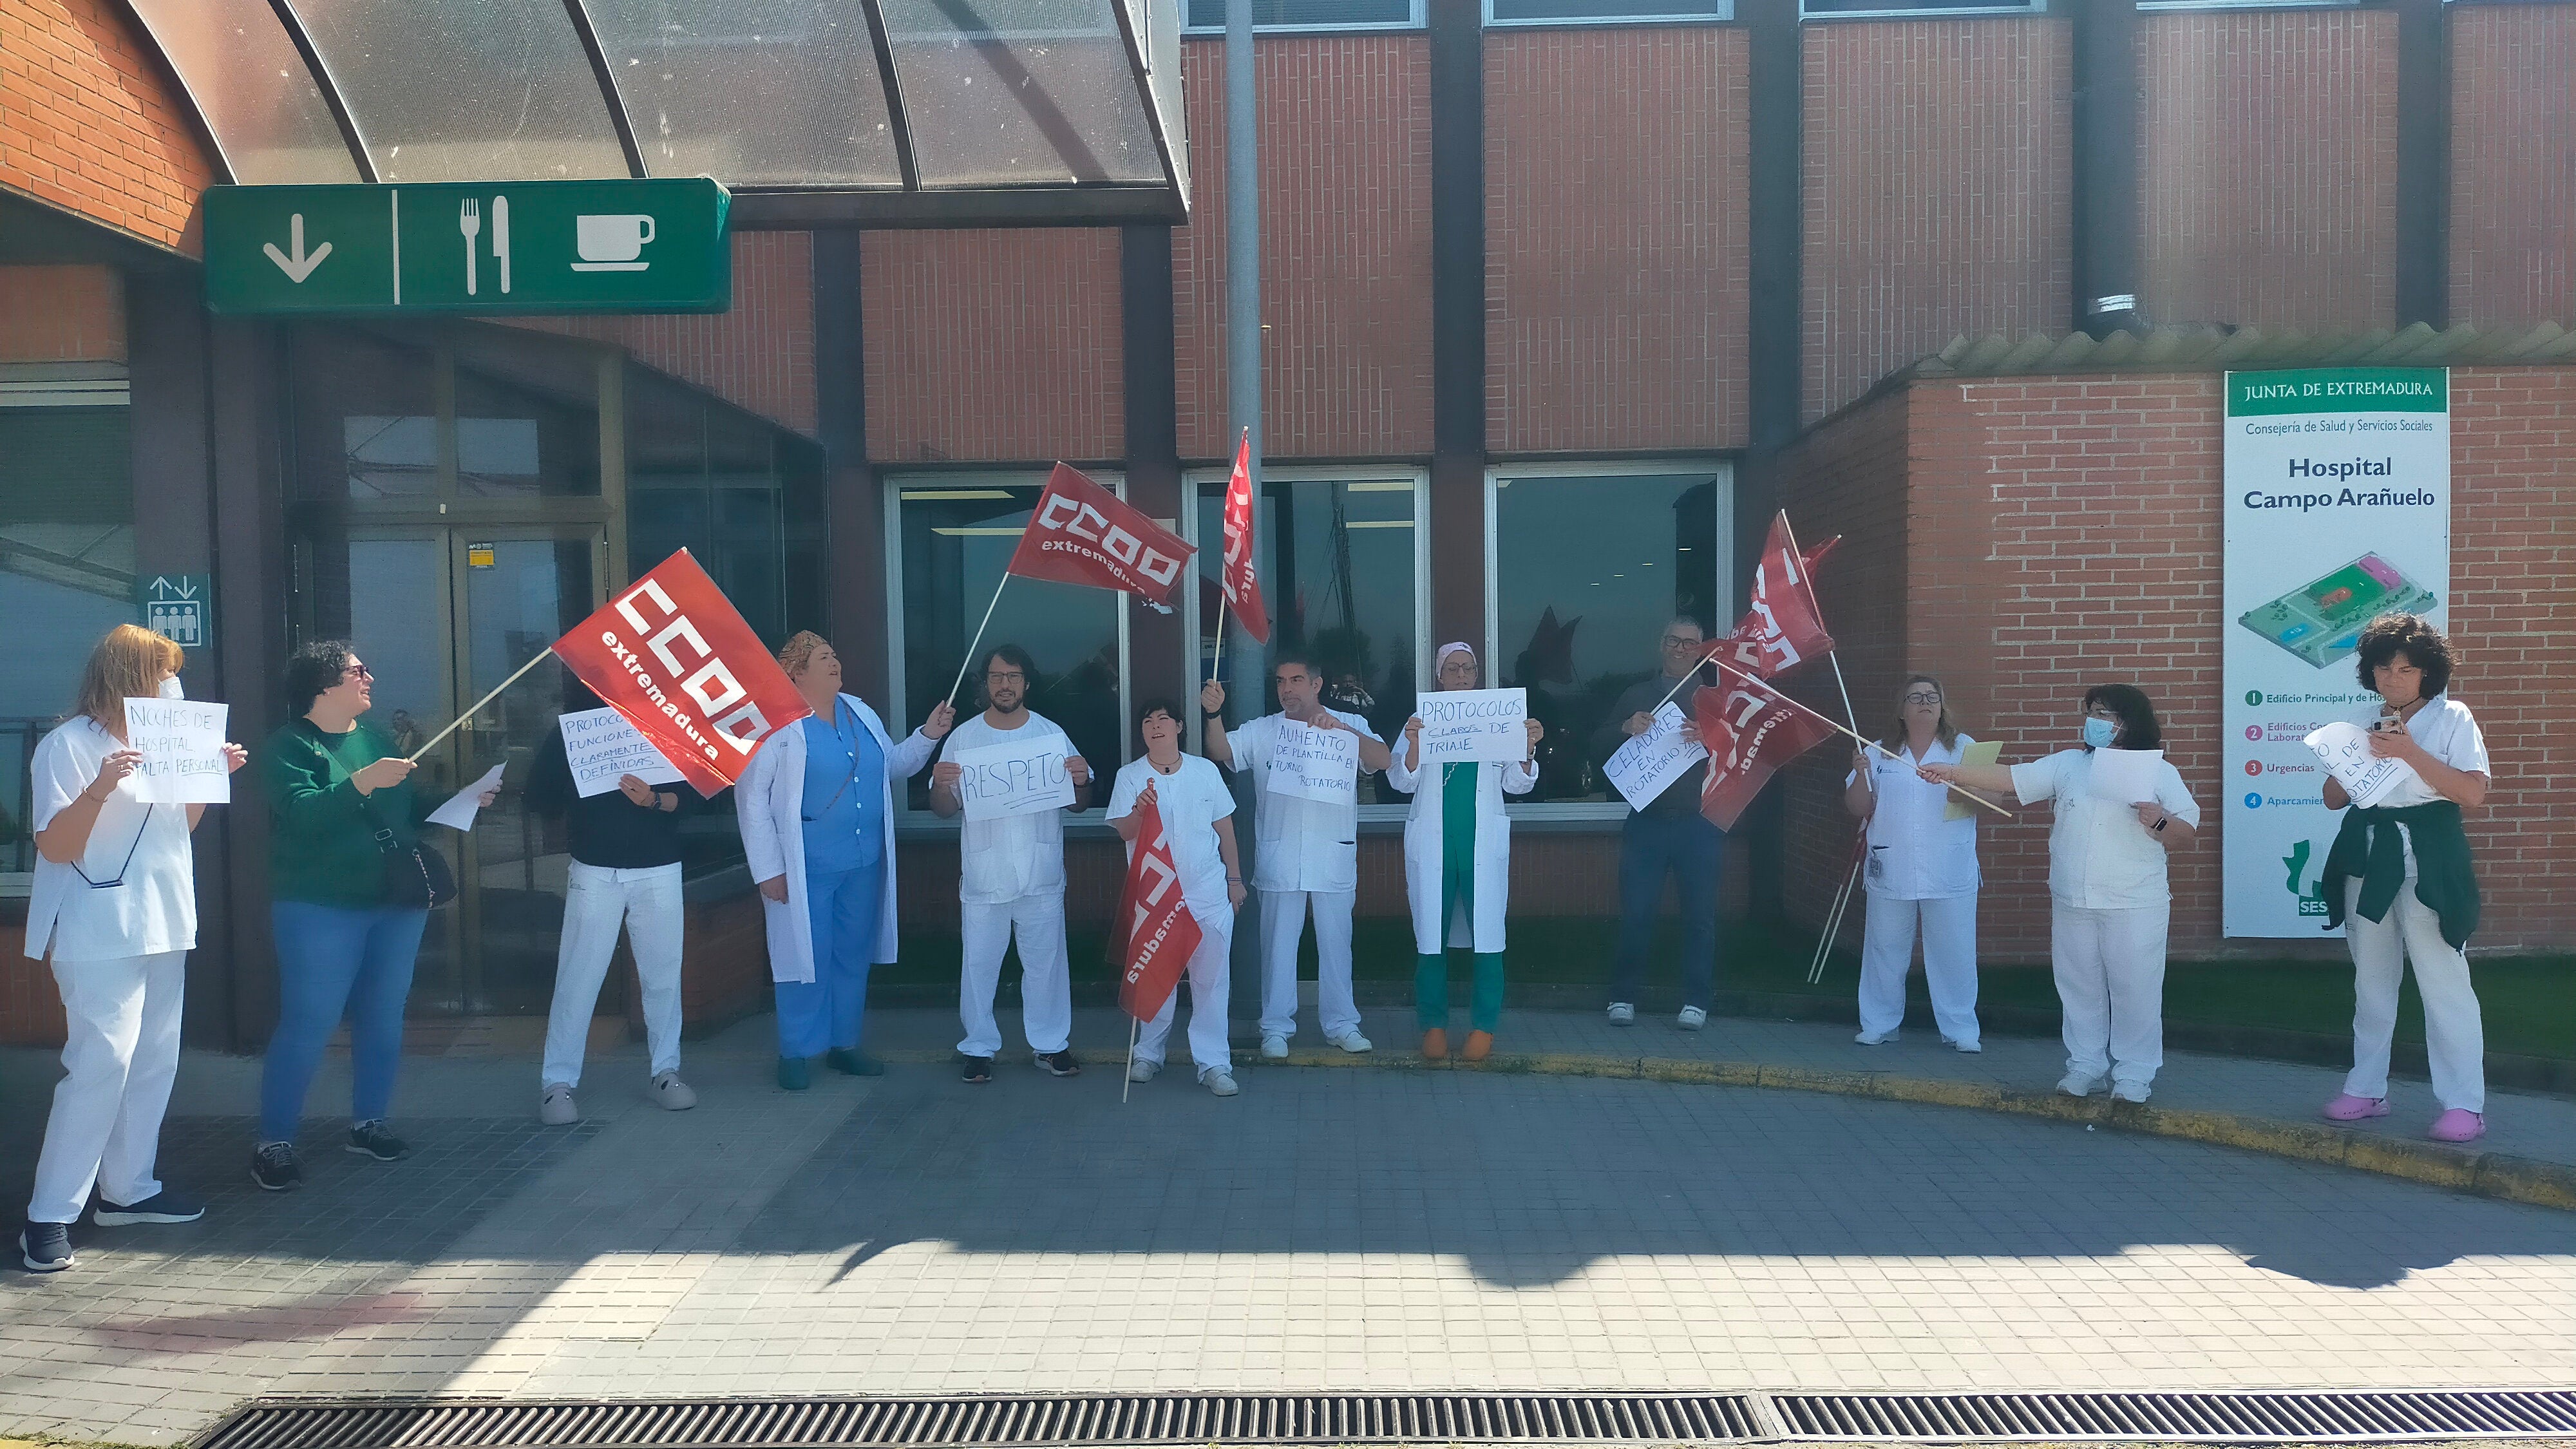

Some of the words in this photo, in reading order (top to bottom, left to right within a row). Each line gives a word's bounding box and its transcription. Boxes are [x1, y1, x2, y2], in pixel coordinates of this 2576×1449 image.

[2245, 384, 2297, 401] JUNTA
[2303, 383, 2322, 397] DE
[2327, 381, 2433, 396] EXTREMADURA
[2246, 421, 2301, 437] Consejería
[2304, 420, 2317, 432] de
[2320, 419, 2346, 431] Salud
[2349, 422, 2354, 434] y
[2357, 419, 2398, 431] Servicios
[2400, 419, 2433, 431] Sociales
[2288, 456, 2392, 482] Hospital
[2243, 491, 2333, 513] Campo
[2336, 487, 2436, 507] Arañuelo
[1037, 493, 1181, 586] CCOO
[614, 578, 772, 756] CCOO
[601, 631, 719, 761] extremadura
[2266, 694, 2302, 703] Edificio
[2305, 693, 2345, 705] Principal
[2348, 696, 2354, 705] y
[2356, 693, 2367, 702] de
[130, 705, 187, 729] NOCHES
[194, 712, 213, 730] DE
[1421, 698, 1522, 723] PROTOCOLOS
[1278, 724, 1347, 752] AUMENTO
[1490, 722, 1510, 734] DE
[2268, 723, 2307, 731] Edificios
[1276, 744, 1289, 755] DE
[1292, 750, 1343, 762] PLANTILLA
[1608, 708, 1685, 778] CELADORES
[2342, 737, 2360, 758] DE
[571, 742, 652, 767] CLARAMENTE
[1637, 750, 1656, 772] EN
[176, 759, 225, 773] PERSONAL
[580, 755, 654, 781] DEFINIDAS
[961, 752, 1066, 802] RESPETO
[1275, 759, 1303, 773] TURNO
[1625, 747, 1680, 799] ROTATORIO
[2266, 763, 2315, 775] Urgencias
[2344, 755, 2365, 777] EN
[1298, 775, 1351, 791] ROTATORIO
[2300, 901, 2328, 913] SES
